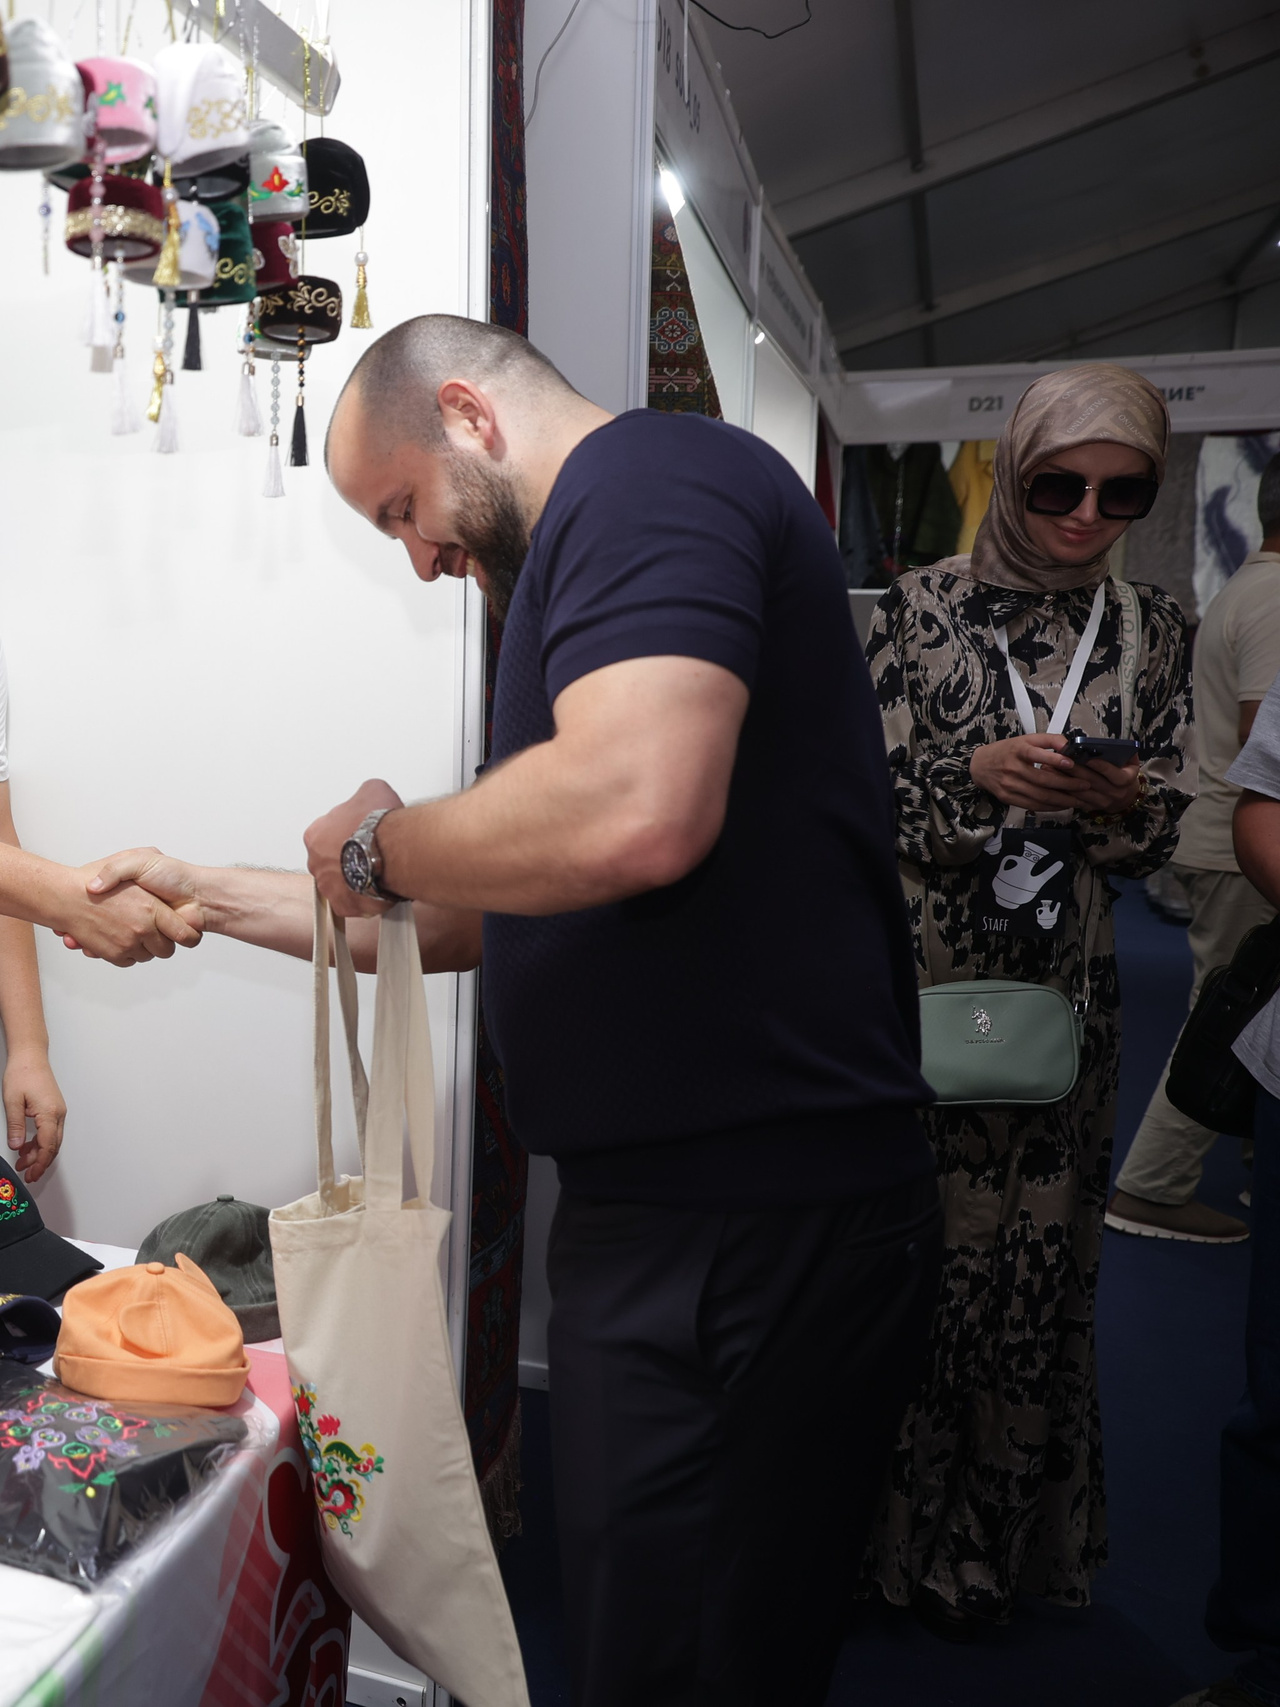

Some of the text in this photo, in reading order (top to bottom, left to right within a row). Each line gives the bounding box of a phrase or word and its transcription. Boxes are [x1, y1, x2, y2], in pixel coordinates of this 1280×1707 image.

[969, 395, 1004, 412] D21
[1066, 396, 1110, 435] VALENTINO
[1115, 585, 1135, 634] POLO
[982, 916, 1010, 932] STAFF
